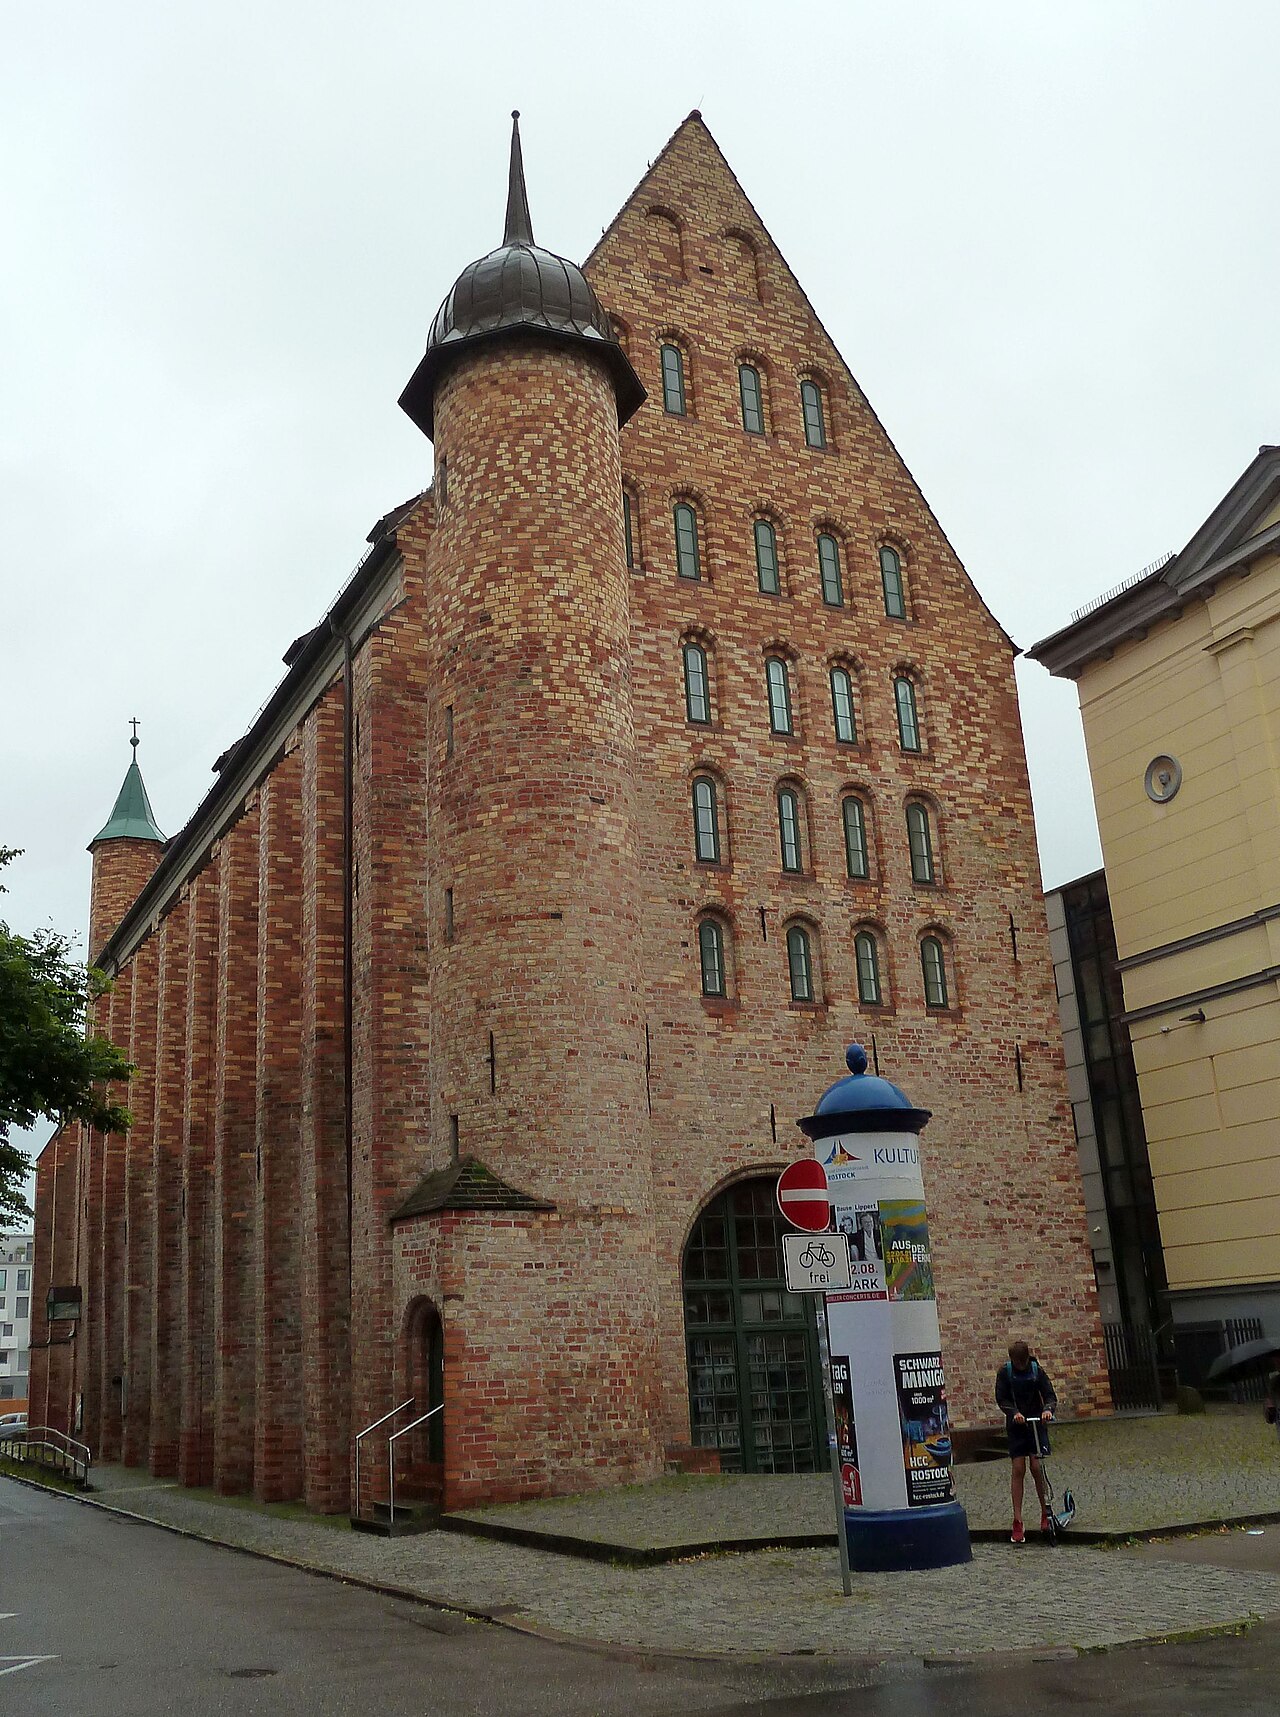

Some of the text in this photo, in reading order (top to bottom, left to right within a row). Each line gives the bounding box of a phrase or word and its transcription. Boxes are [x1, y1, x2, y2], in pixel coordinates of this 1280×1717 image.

[854, 1203, 877, 1211] Lippert
[892, 1240, 911, 1250] AUS
[911, 1244, 926, 1253] DER
[809, 1270, 830, 1284] frei
[910, 1456, 929, 1467] HCC
[910, 1466, 949, 1481] ROSTOCK
